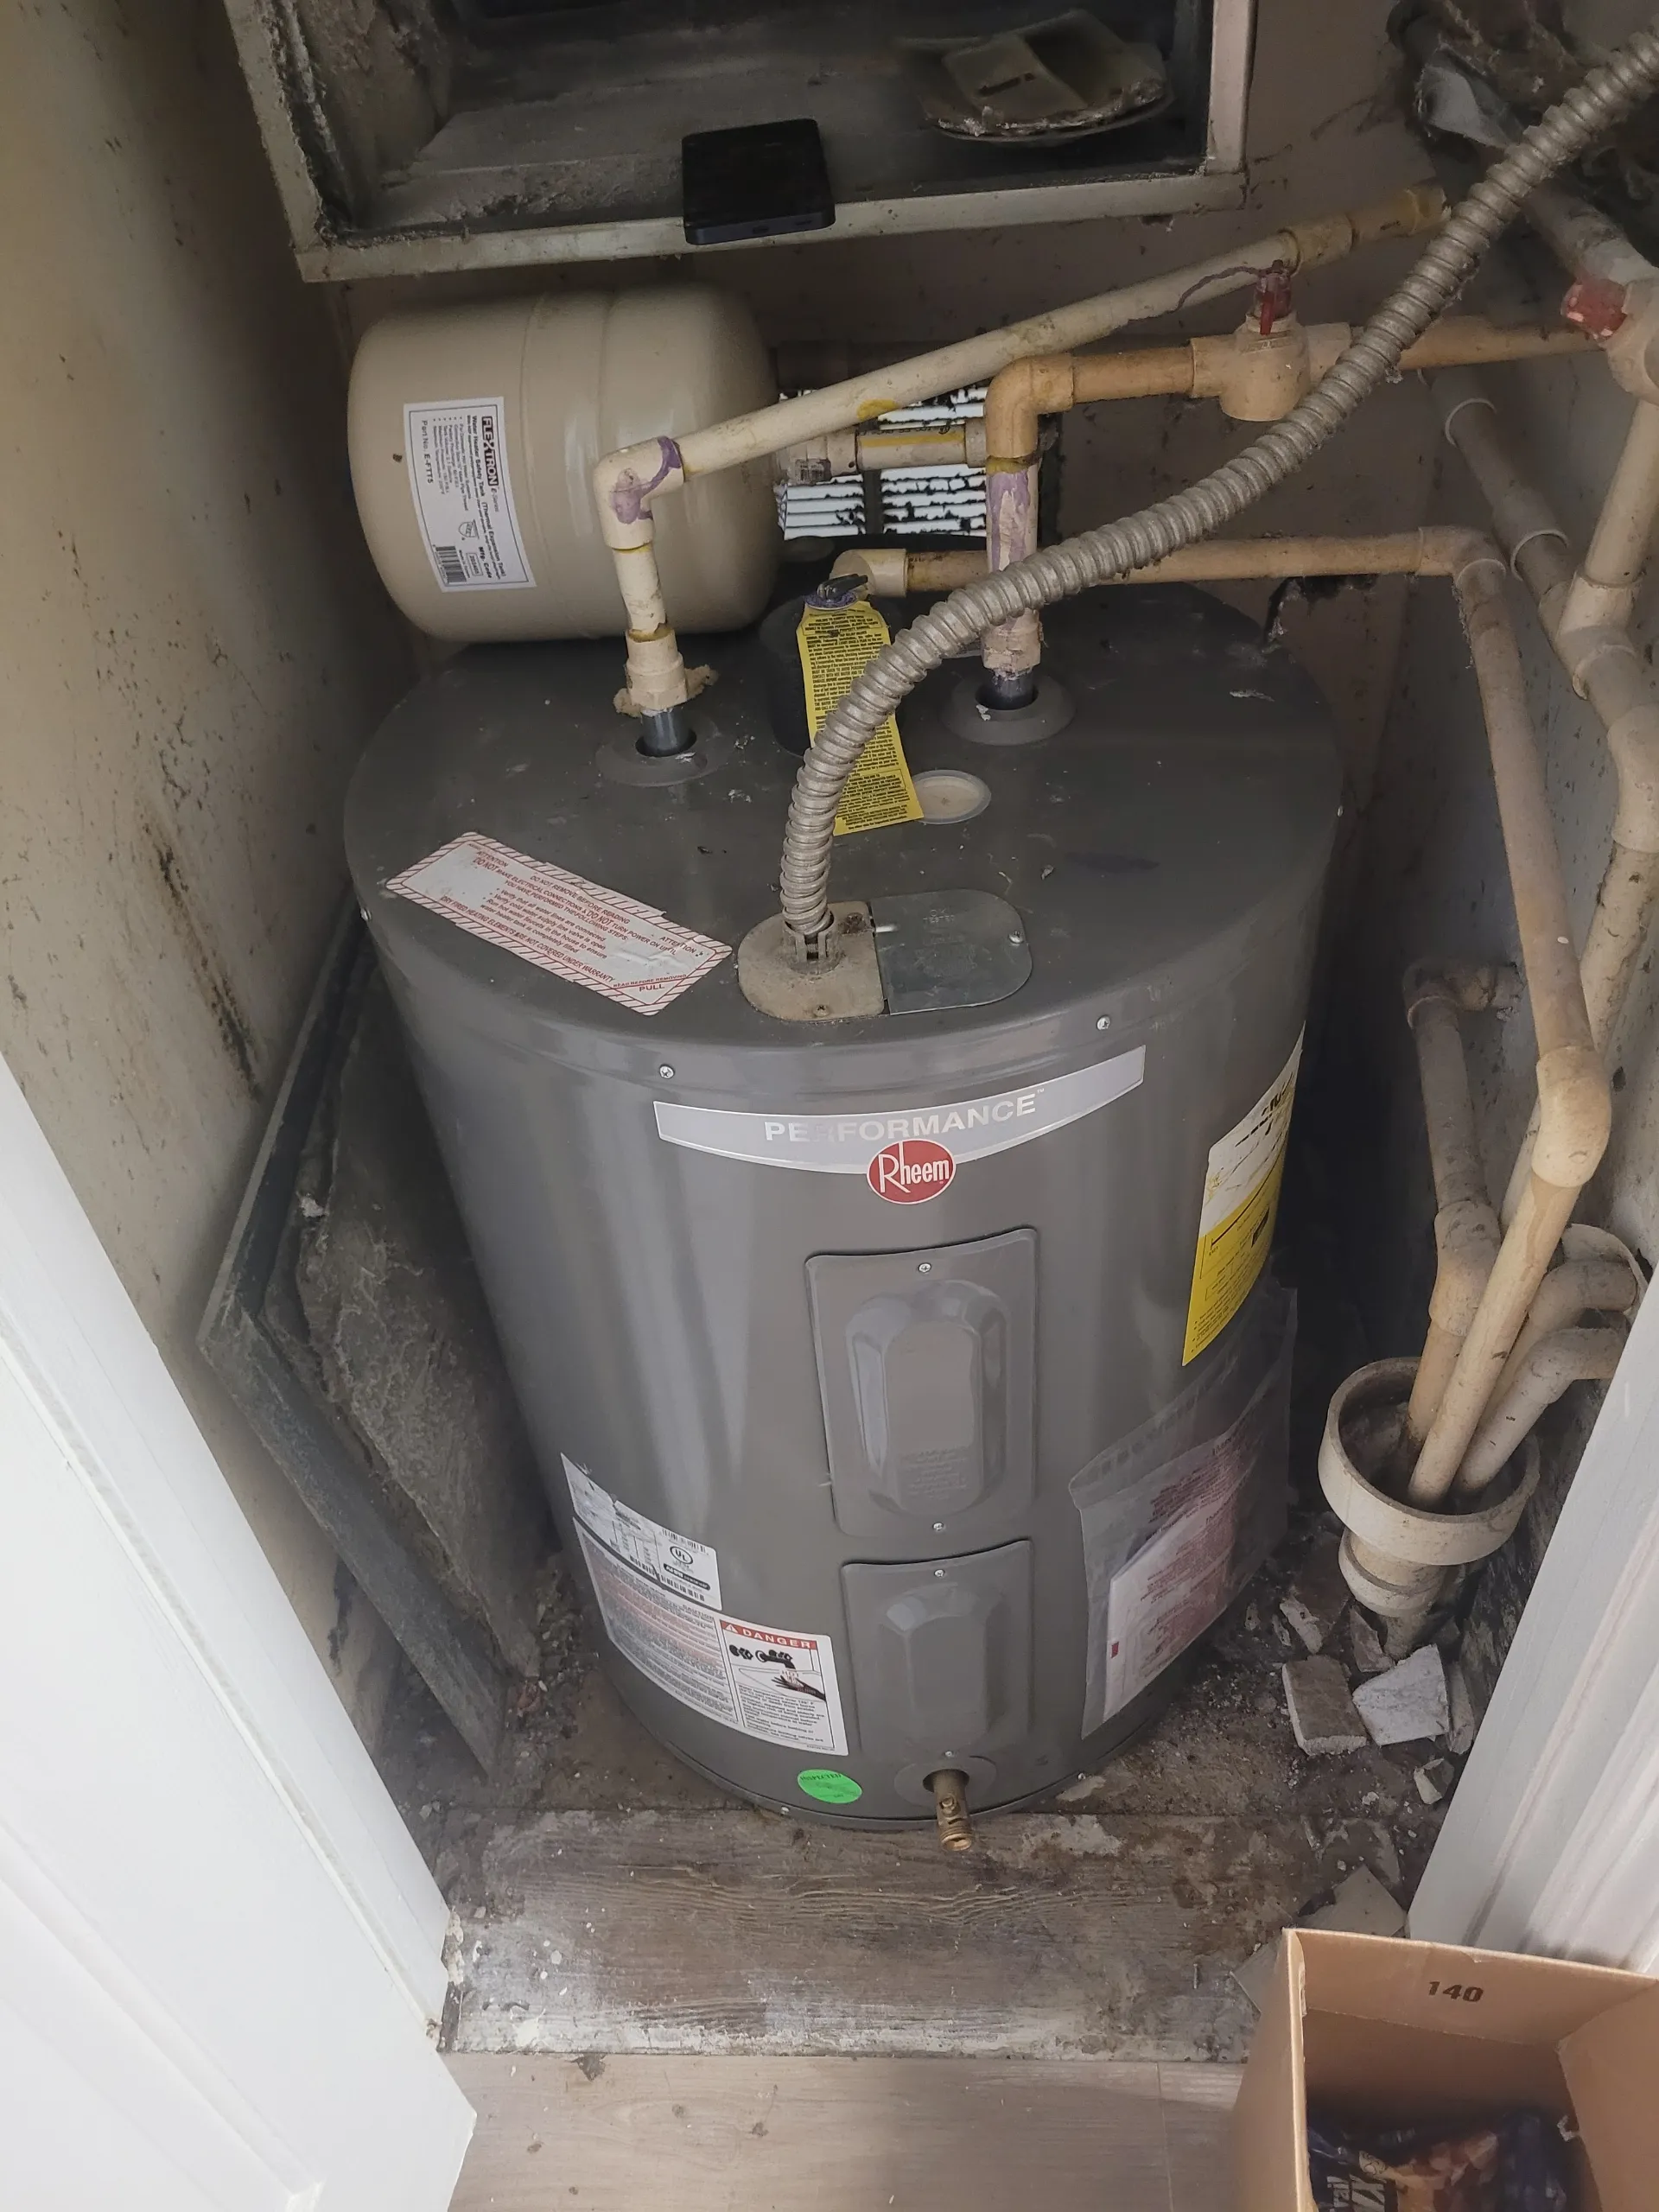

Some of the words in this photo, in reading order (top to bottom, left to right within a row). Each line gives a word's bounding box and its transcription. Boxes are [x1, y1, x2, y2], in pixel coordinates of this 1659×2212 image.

[423, 454, 435, 484] E-FTT5
[483, 417, 498, 485] FLEXTRON
[474, 460, 483, 480] Safety
[481, 502, 492, 530] (Thermal
[488, 531, 500, 561] Expansion
[498, 563, 506, 576] Tank)
[478, 547, 486, 561] Mfg.
[484, 563, 493, 578] Code
[472, 857, 486, 866] DO
[481, 861, 499, 872] NOT
[495, 869, 513, 879] MAKE
[511, 876, 545, 893] ELECTRICAL
[542, 891, 583, 911] CONNECTIONS
[584, 911, 600, 919] DO
[596, 916, 614, 926] NOT
[610, 923, 629, 933] TURN
[626, 931, 652, 944] POWER
[476, 850, 510, 868] ATTENTION
[551, 884, 579, 898] REMOVE
[574, 896, 606, 912] BEFORE
[601, 909, 632, 925] READING
[659, 935, 697, 954] ATTENTION
[492, 894, 511, 905] Verify
[522, 908, 538, 917] water
[537, 915, 558, 927] supply
[568, 930, 585, 939] valve
[588, 941, 607, 950] open
[499, 890, 518, 899] Verify
[534, 906, 551, 915] water
[550, 913, 566, 922] lines
[574, 925, 607, 942] connected
[516, 886, 532, 894] HAVE
[530, 892, 565, 909] PERFORMED
[573, 913, 610, 931] FOLLOWING
[450, 901, 469, 912] FIRED
[465, 908, 491, 922] HEATING
[486, 918, 518, 935] ELEMENTS
[512, 931, 528, 940] ARE
[524, 938, 540, 946] NOT
[536, 943, 566, 958] COVERED
[562, 955, 585, 969] UNDER
[581, 964, 616, 983] WARRANTY
[480, 905, 497, 913] water
[494, 912, 515, 922] heater
[531, 929, 563, 946] completely
[562, 944, 580, 953] filled
[508, 910, 524, 918] water
[523, 917, 546, 929] faucets
[560, 935, 581, 945] house
[586, 947, 608, 959] ensure
[639, 983, 664, 992] PULL
[765, 1093, 1036, 1142] PERFORMANCE
[880, 1141, 950, 1193] Rheem
[742, 1629, 810, 1649] DANGER
[1428, 1981, 1484, 2002] 140
